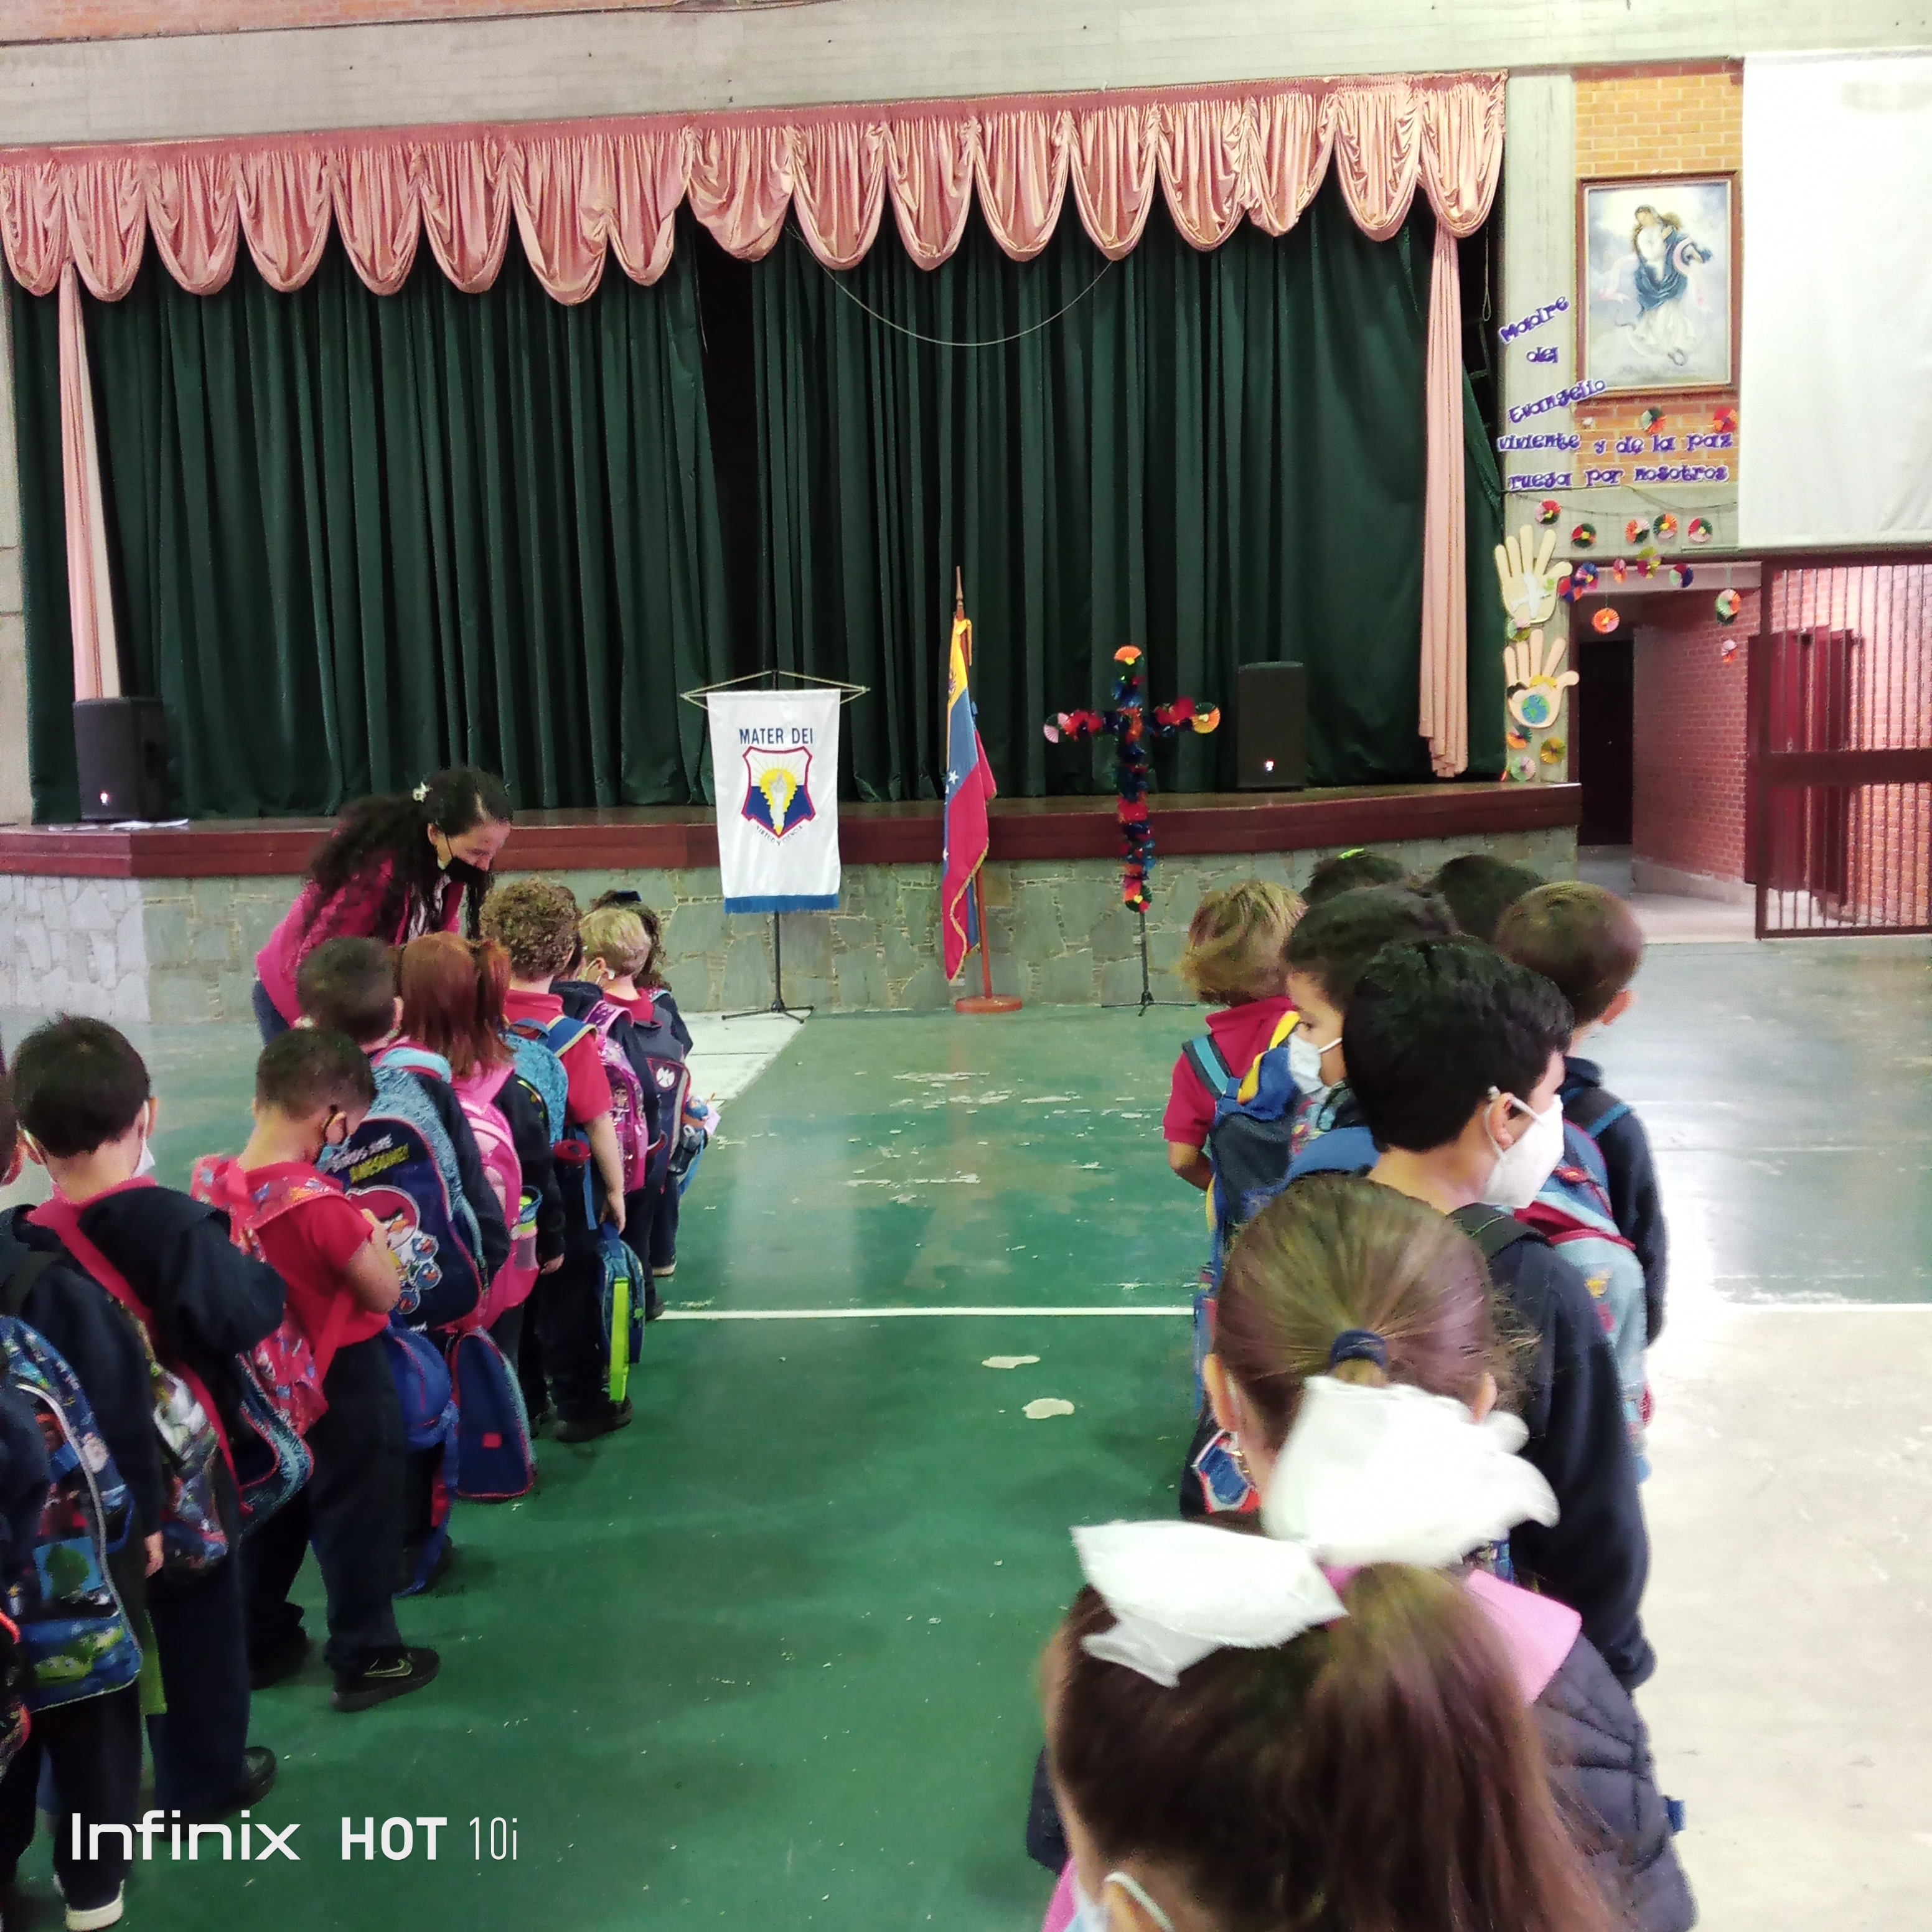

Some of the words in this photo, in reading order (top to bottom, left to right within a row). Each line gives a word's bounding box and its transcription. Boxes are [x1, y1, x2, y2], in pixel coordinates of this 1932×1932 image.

[1500, 296, 1570, 343] Madre
[1527, 347, 1559, 363] del
[1509, 380, 1606, 423] Evangelio
[1498, 433, 1581, 451] viviente
[1595, 439, 1606, 454] y
[1616, 436, 1644, 454] de
[1653, 434, 1676, 452] la
[1687, 433, 1733, 451] paz
[1509, 471, 1572, 490] ruega
[1585, 468, 1624, 486] por
[1635, 465, 1728, 482] nosotros
[739, 728, 784, 744] MATER
[792, 728, 814, 744] DEI
